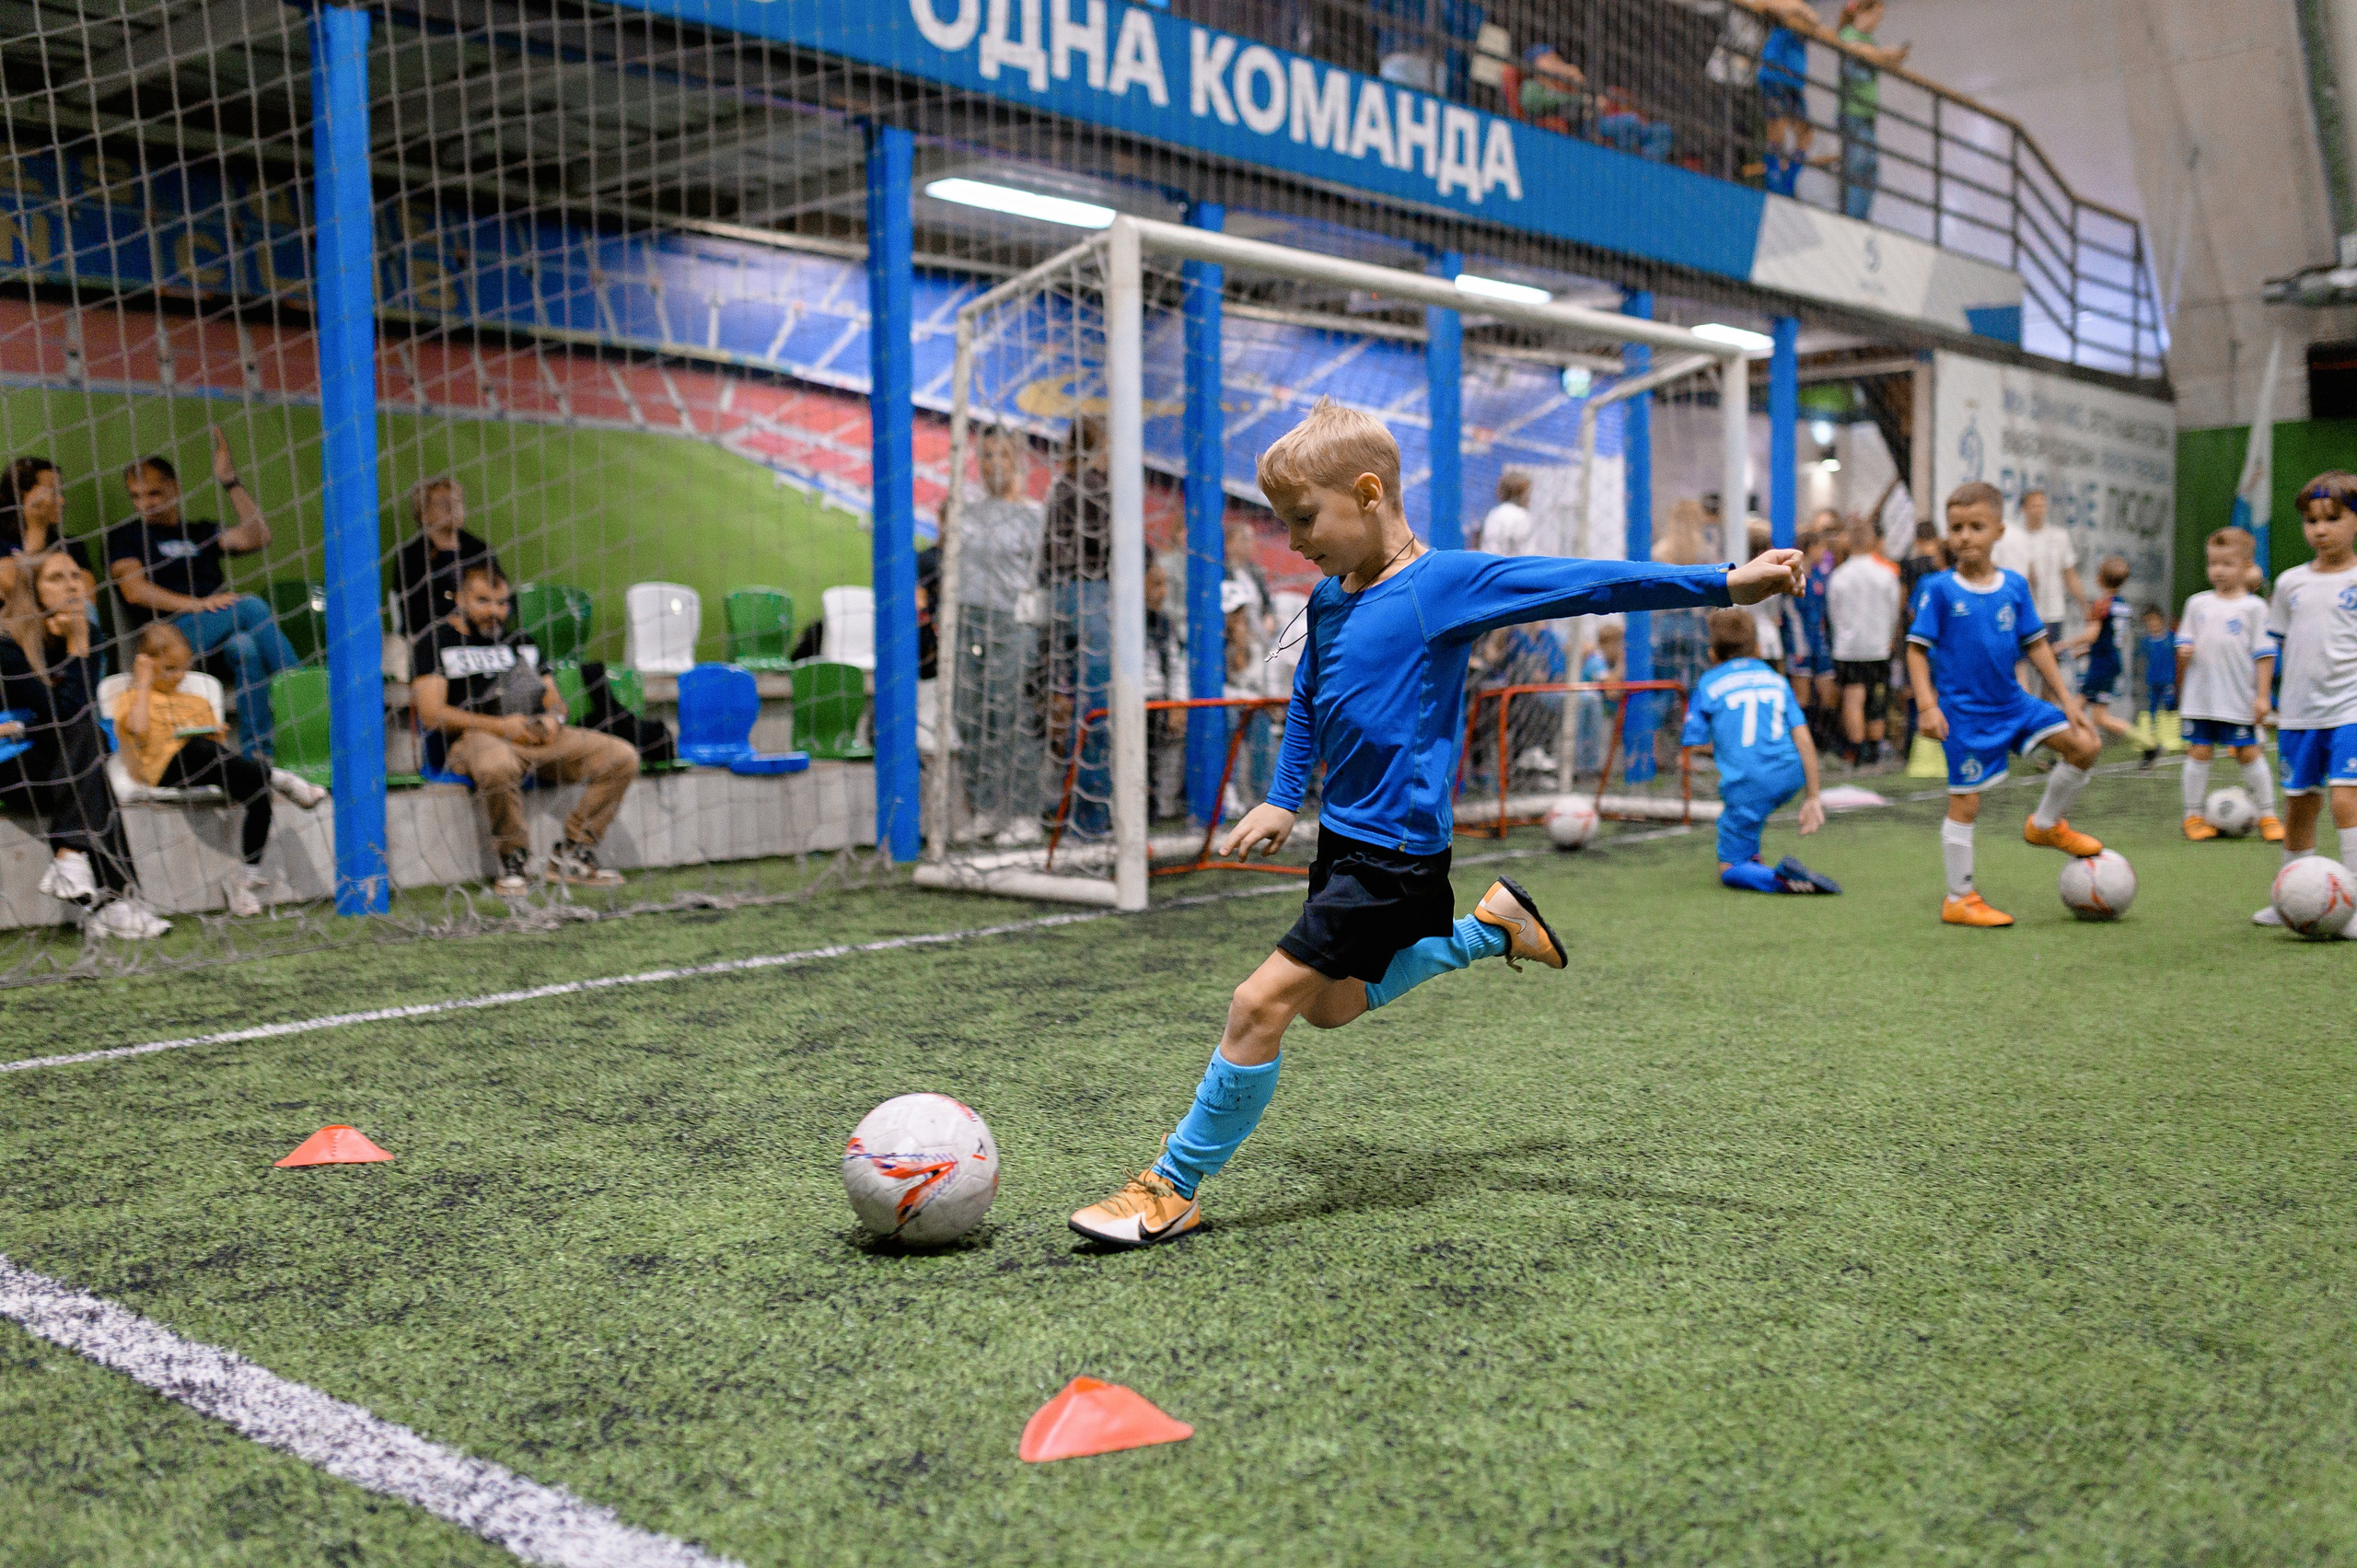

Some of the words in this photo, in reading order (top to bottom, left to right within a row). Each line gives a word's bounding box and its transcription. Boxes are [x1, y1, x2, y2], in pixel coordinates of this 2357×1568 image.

[910, 0, 1169, 107] ОДНА
[1190, 27, 1522, 203] КОМАНДА
[1725, 689, 1786, 749] 77
